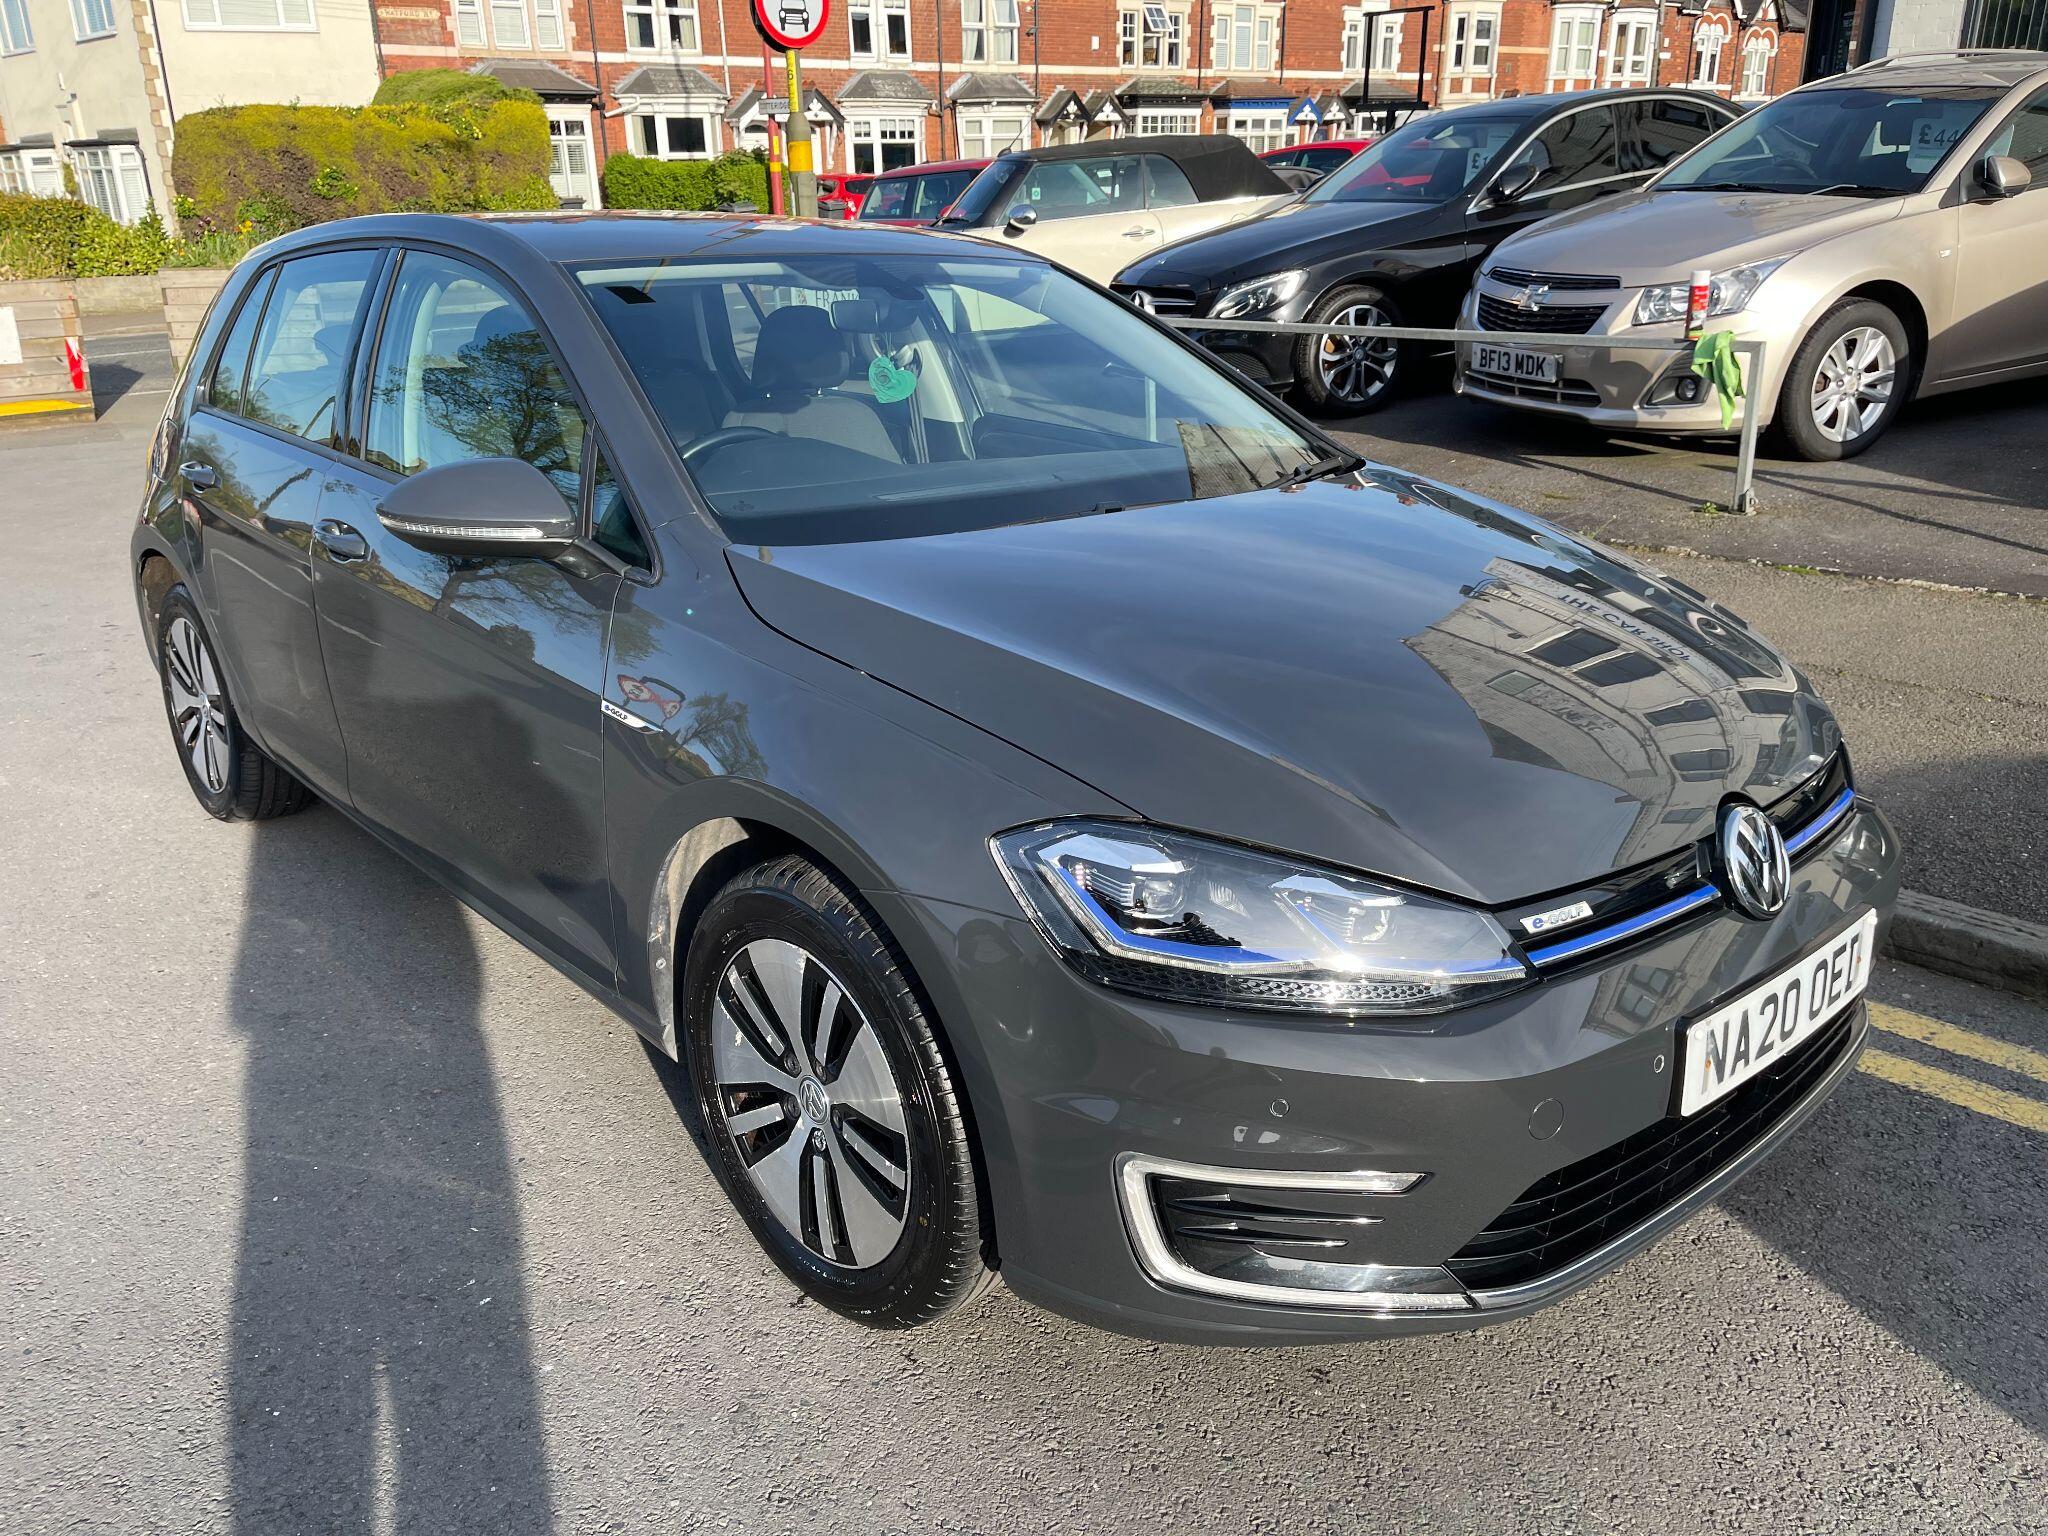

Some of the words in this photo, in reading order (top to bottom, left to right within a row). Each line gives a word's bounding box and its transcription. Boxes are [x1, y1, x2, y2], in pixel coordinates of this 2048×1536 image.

[1479, 347, 1511, 372] BF13
[1514, 352, 1547, 378] MDK
[1701, 977, 1801, 1096] NA20
